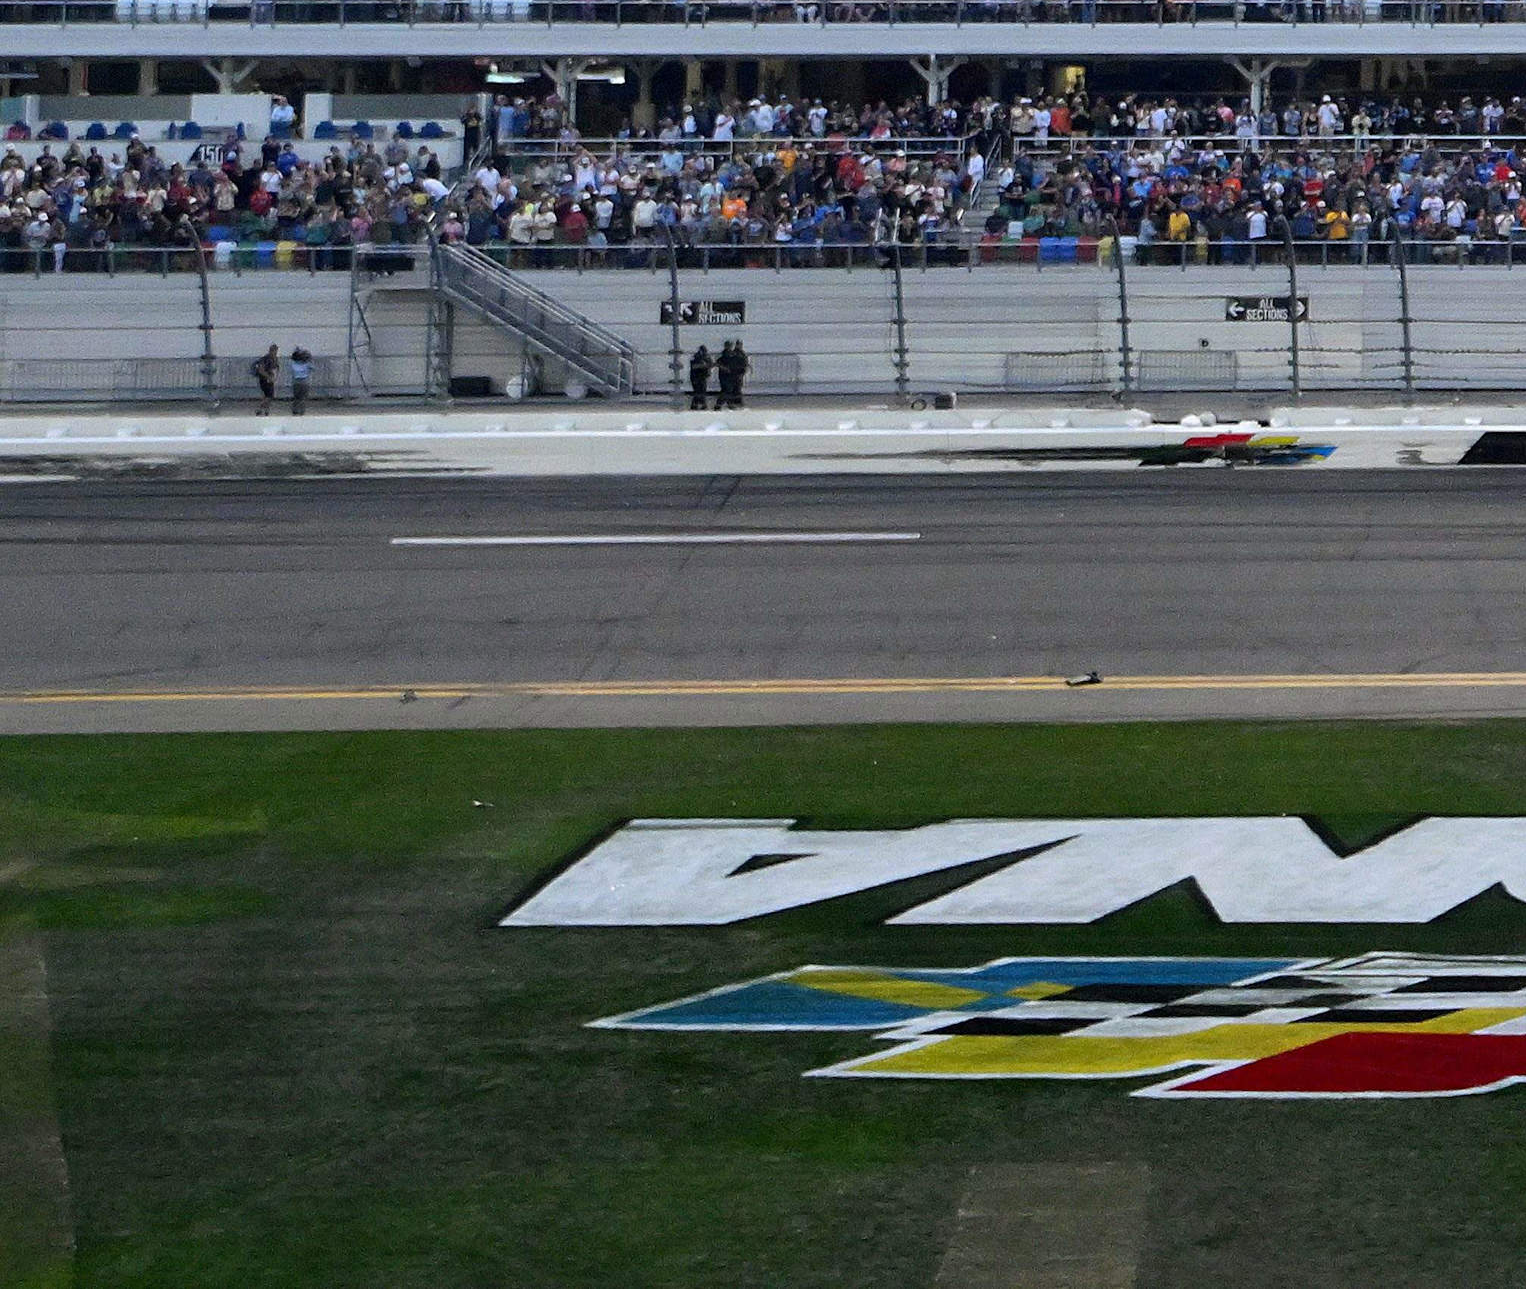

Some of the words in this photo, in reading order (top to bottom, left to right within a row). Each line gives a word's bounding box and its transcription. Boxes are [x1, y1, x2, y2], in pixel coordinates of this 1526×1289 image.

[698, 301, 714, 313] ALL
[1259, 298, 1275, 309] ALL
[698, 313, 742, 324] SECTIONS
[1245, 309, 1289, 320] SECTIONS
